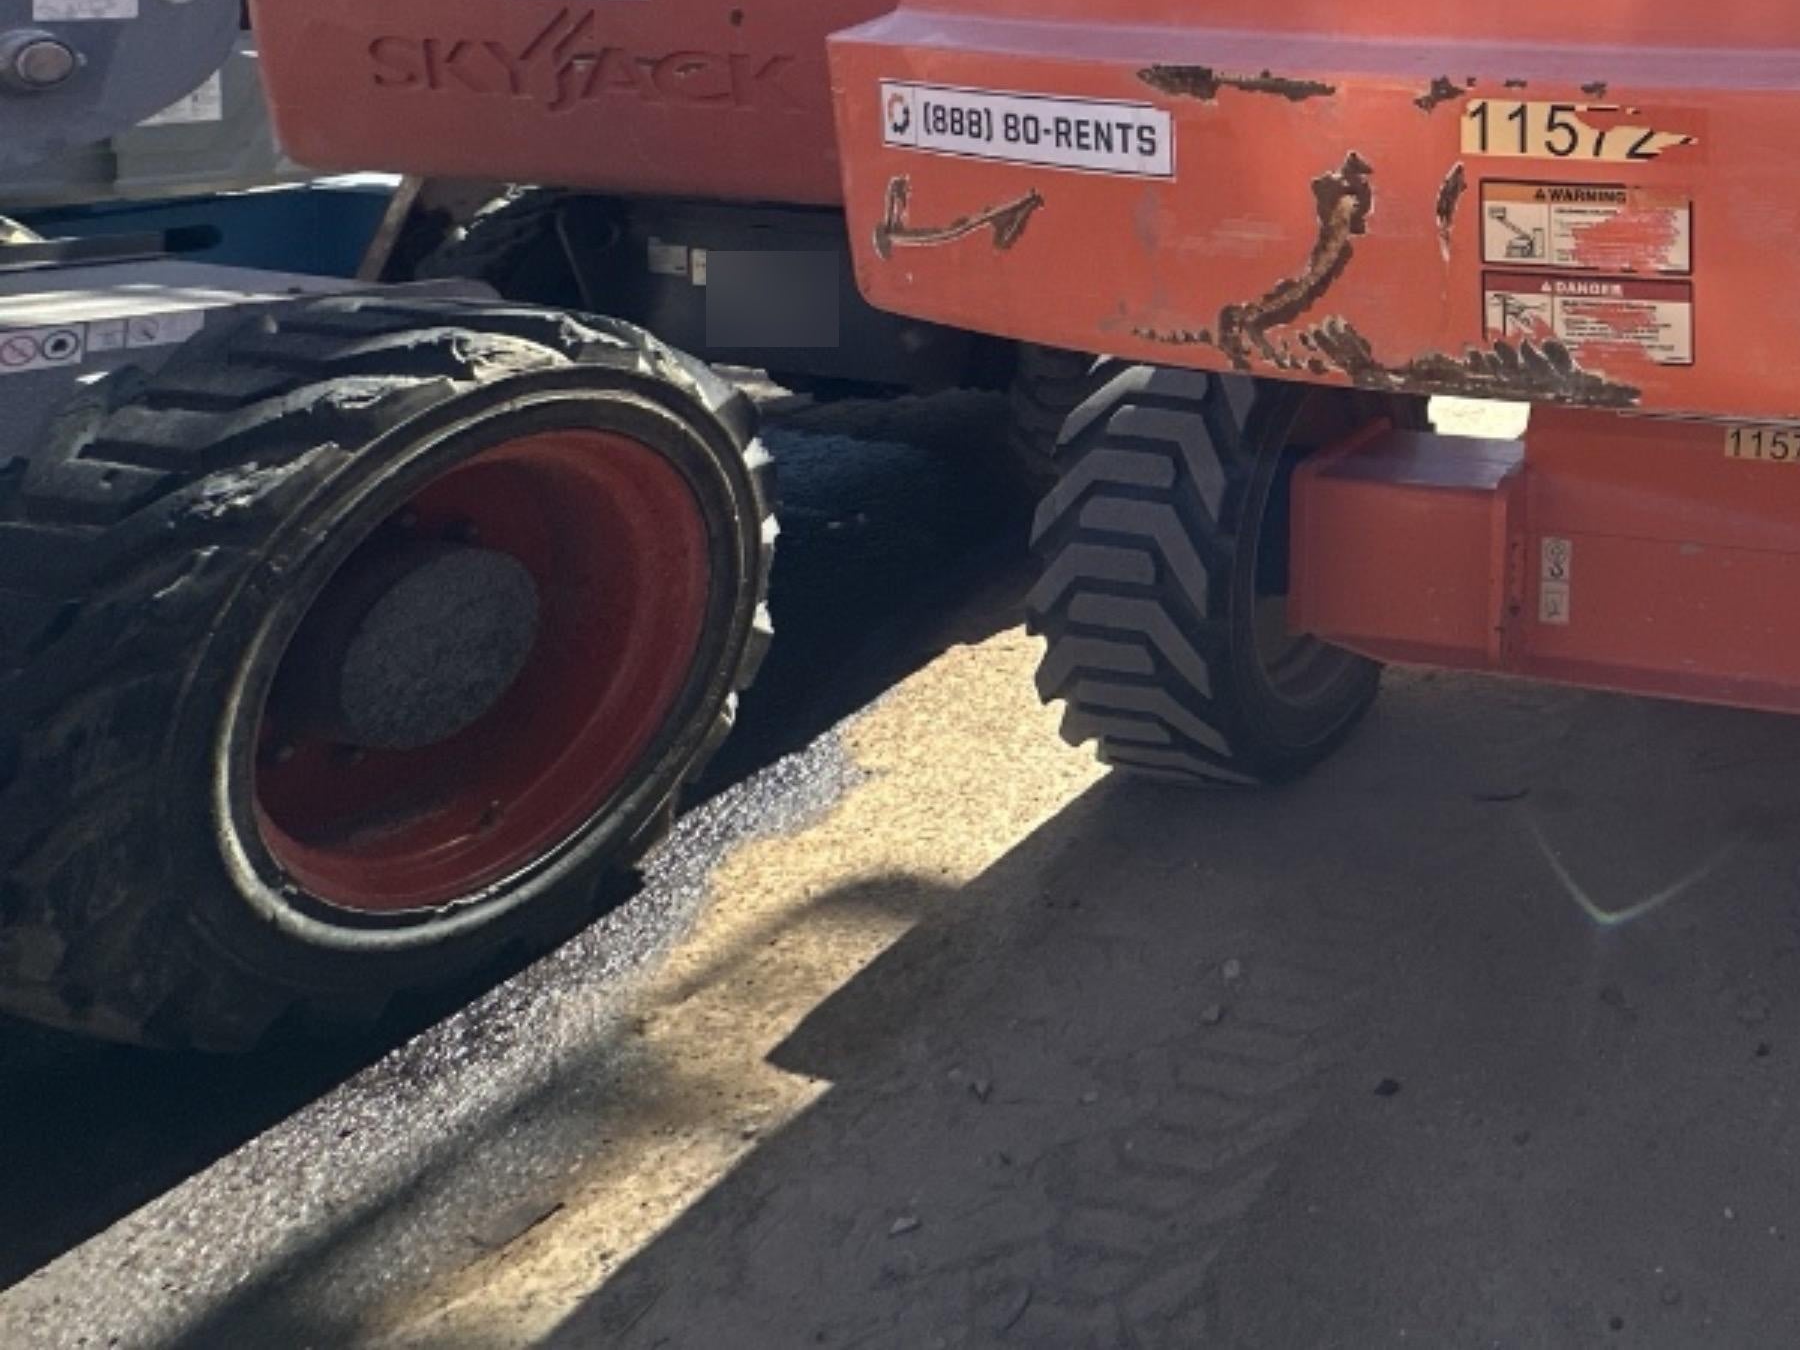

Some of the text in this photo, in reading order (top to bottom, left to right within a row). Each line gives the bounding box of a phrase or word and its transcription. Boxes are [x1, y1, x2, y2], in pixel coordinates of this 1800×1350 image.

[367, 7, 810, 113] SKYJACK
[922, 100, 1157, 157] (888) 80-RENTS
[1468, 101, 1693, 160] 11572
